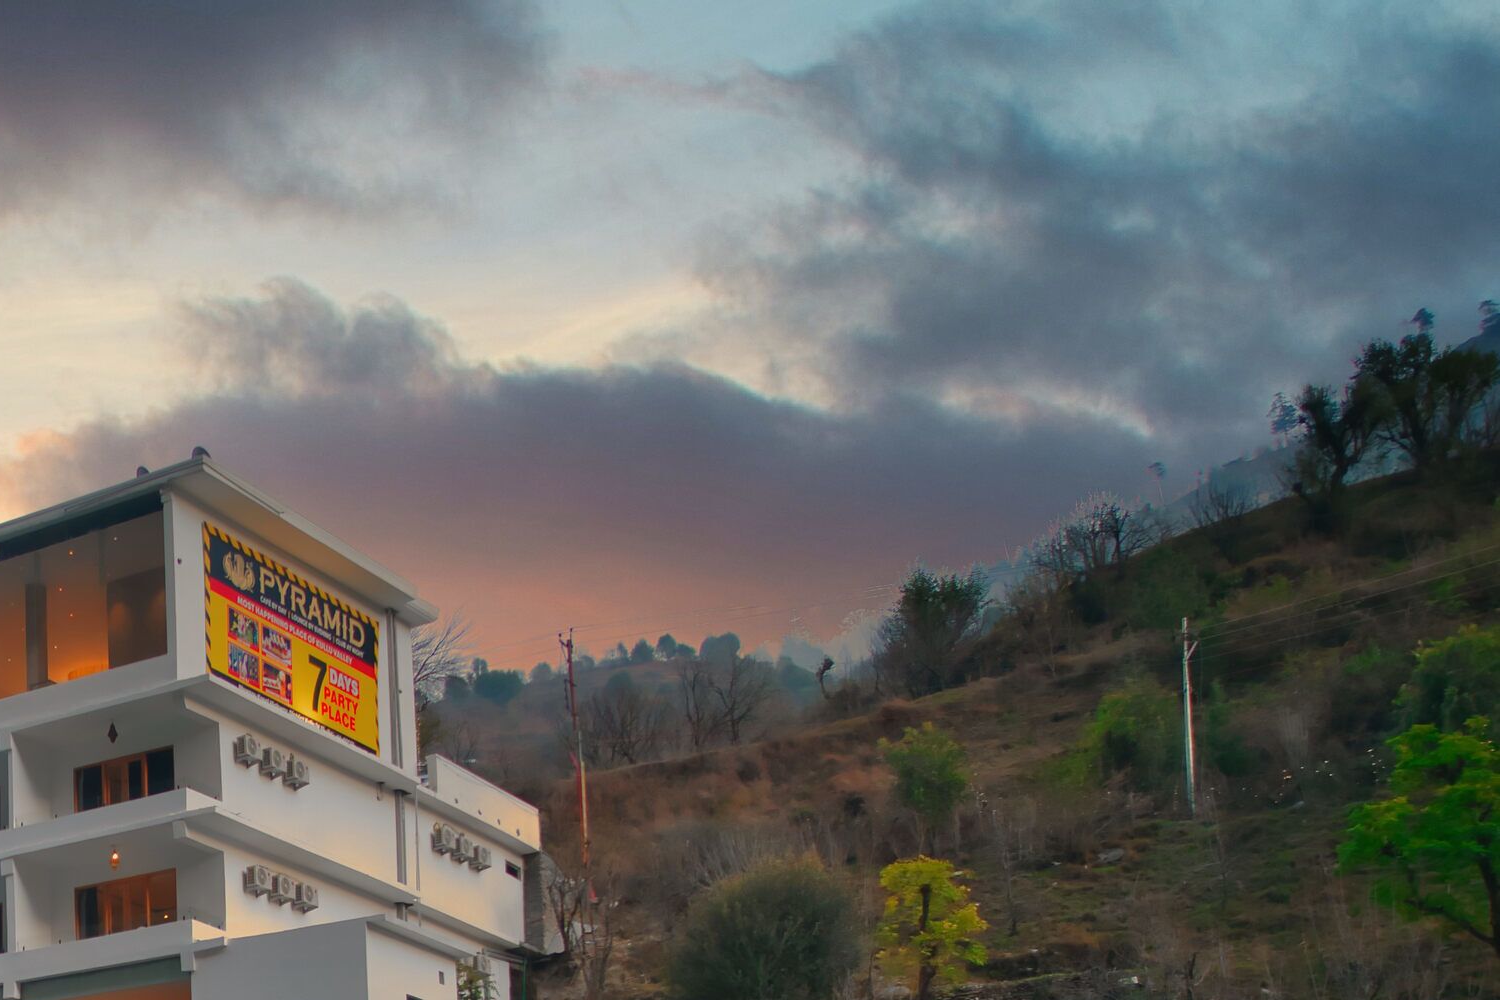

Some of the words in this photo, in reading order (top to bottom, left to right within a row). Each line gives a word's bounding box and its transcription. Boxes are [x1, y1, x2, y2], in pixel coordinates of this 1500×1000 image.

[237, 596, 255, 612] MOST
[255, 606, 288, 630] HAPPENING
[289, 624, 307, 641] PLACE
[308, 634, 315, 645] OF
[316, 639, 333, 654] KULLU
[332, 650, 352, 664] VALLEY
[259, 568, 366, 649] PYRAMID
[308, 653, 327, 712] 7
[324, 686, 358, 715] PARTY
[329, 668, 359, 696] DAYS
[321, 701, 356, 731] PLACE
